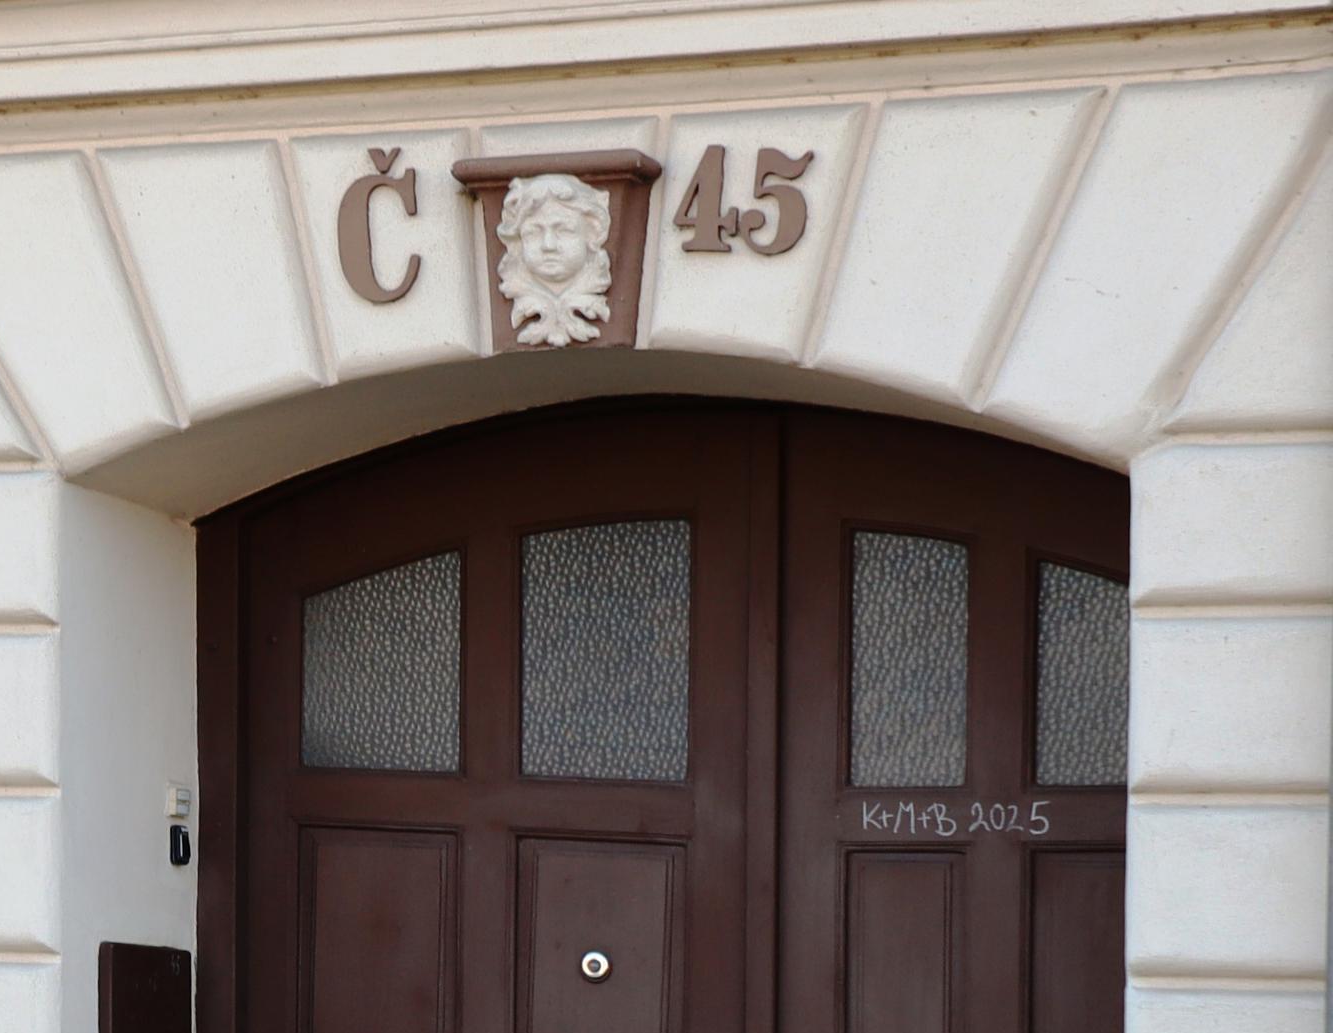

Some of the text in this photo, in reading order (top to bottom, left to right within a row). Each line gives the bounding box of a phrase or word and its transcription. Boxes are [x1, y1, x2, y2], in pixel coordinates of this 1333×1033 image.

[336, 144, 815, 304] Č 45
[862, 801, 1052, 837] K+M+B 2025
